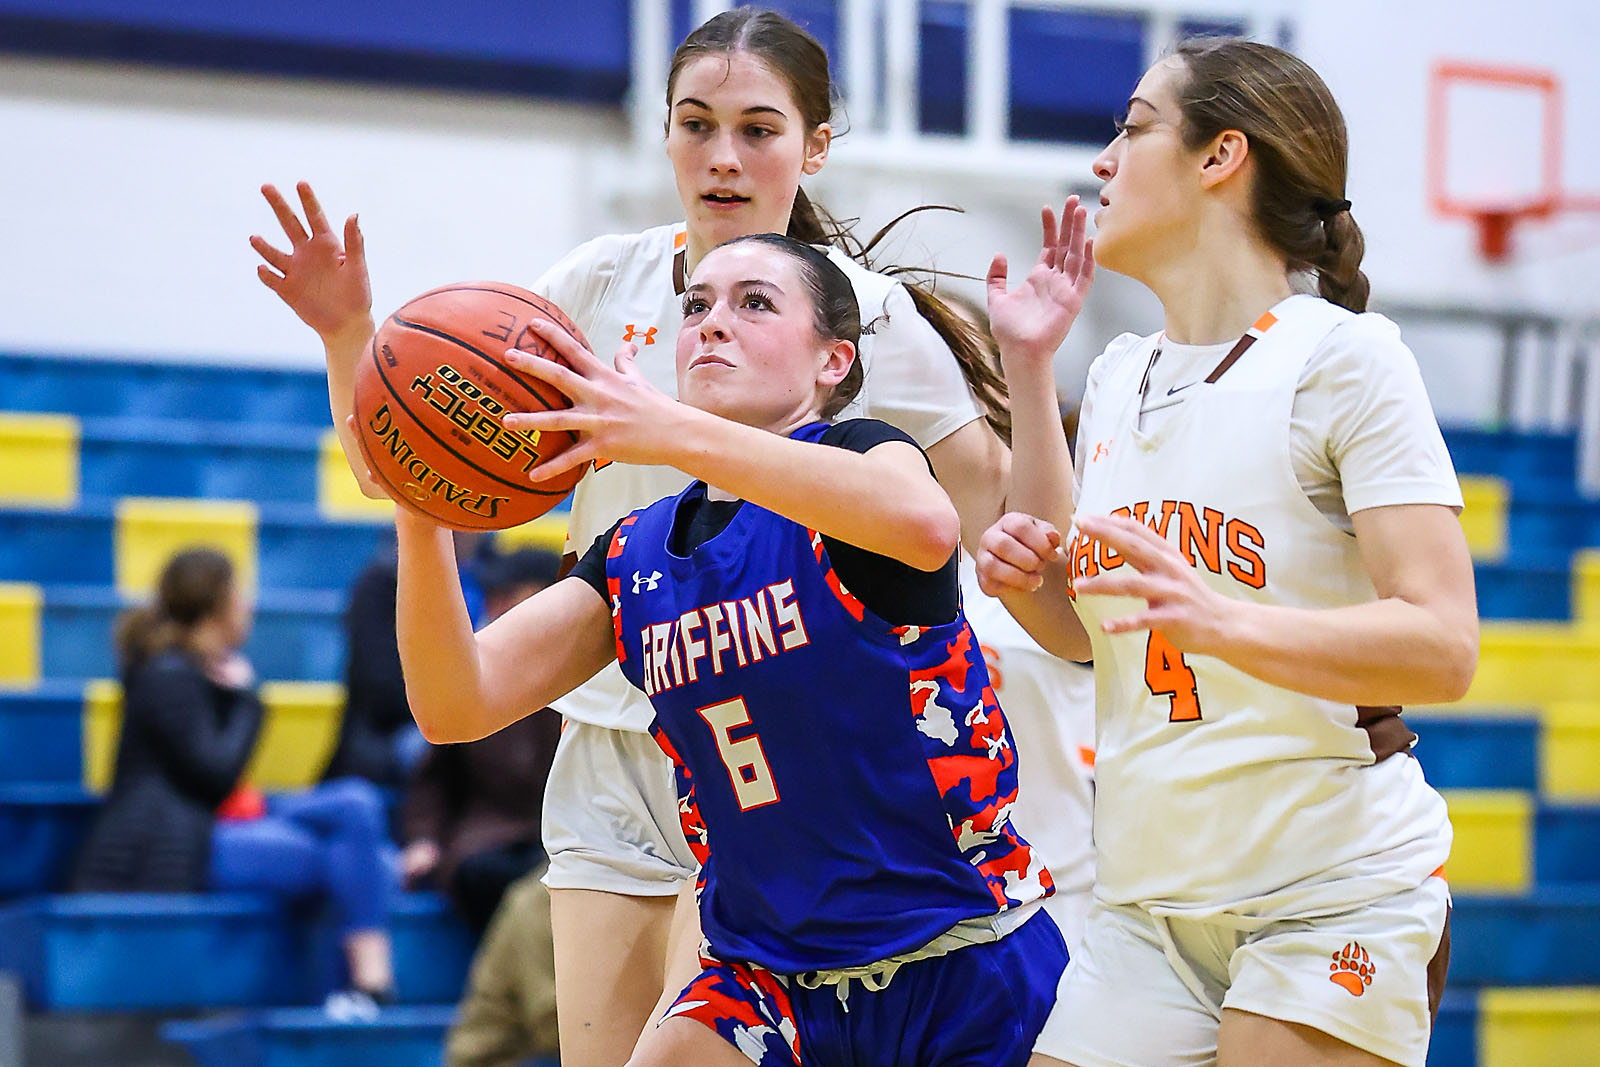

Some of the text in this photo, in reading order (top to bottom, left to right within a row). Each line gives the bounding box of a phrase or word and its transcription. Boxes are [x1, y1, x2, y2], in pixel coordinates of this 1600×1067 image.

[369, 402, 511, 518] SPALDING
[409, 373, 541, 473] LEGACY
[640, 577, 810, 698] GRIFFINS
[1144, 628, 1203, 723] 4
[696, 695, 781, 813] 6
